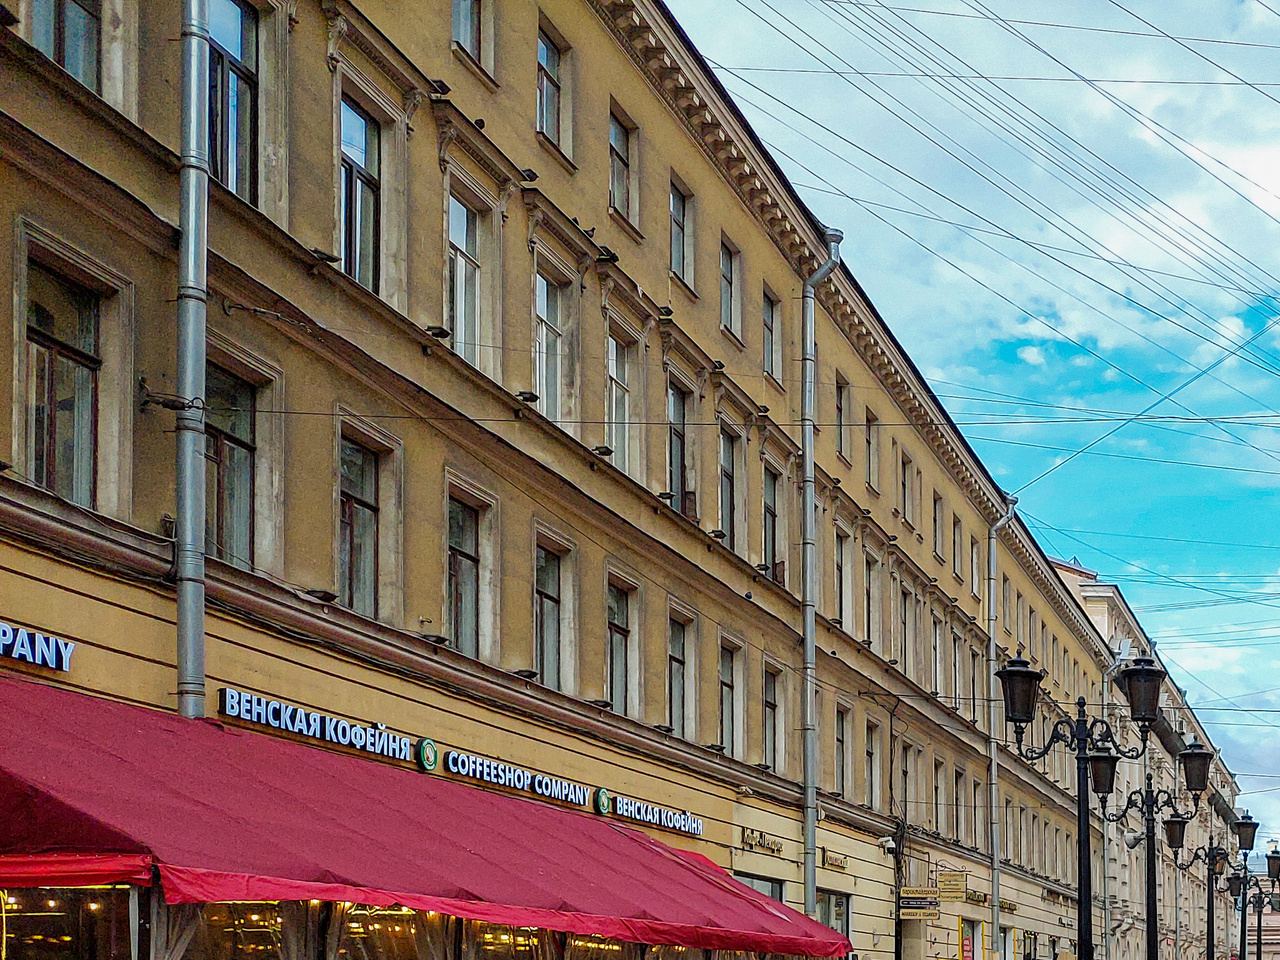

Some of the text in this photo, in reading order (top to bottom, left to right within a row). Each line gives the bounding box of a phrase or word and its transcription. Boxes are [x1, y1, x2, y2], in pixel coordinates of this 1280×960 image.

[0, 622, 75, 672] PANY
[225, 688, 320, 738] ВЕНСКАЯ
[325, 716, 411, 761] КОФЕЙНЯ
[448, 751, 532, 790] COFFEESHOP
[534, 774, 591, 806] COMPANY
[616, 796, 660, 824] ВЕНСКАЯ
[661, 808, 703, 836] КОФЕЙНЯ
